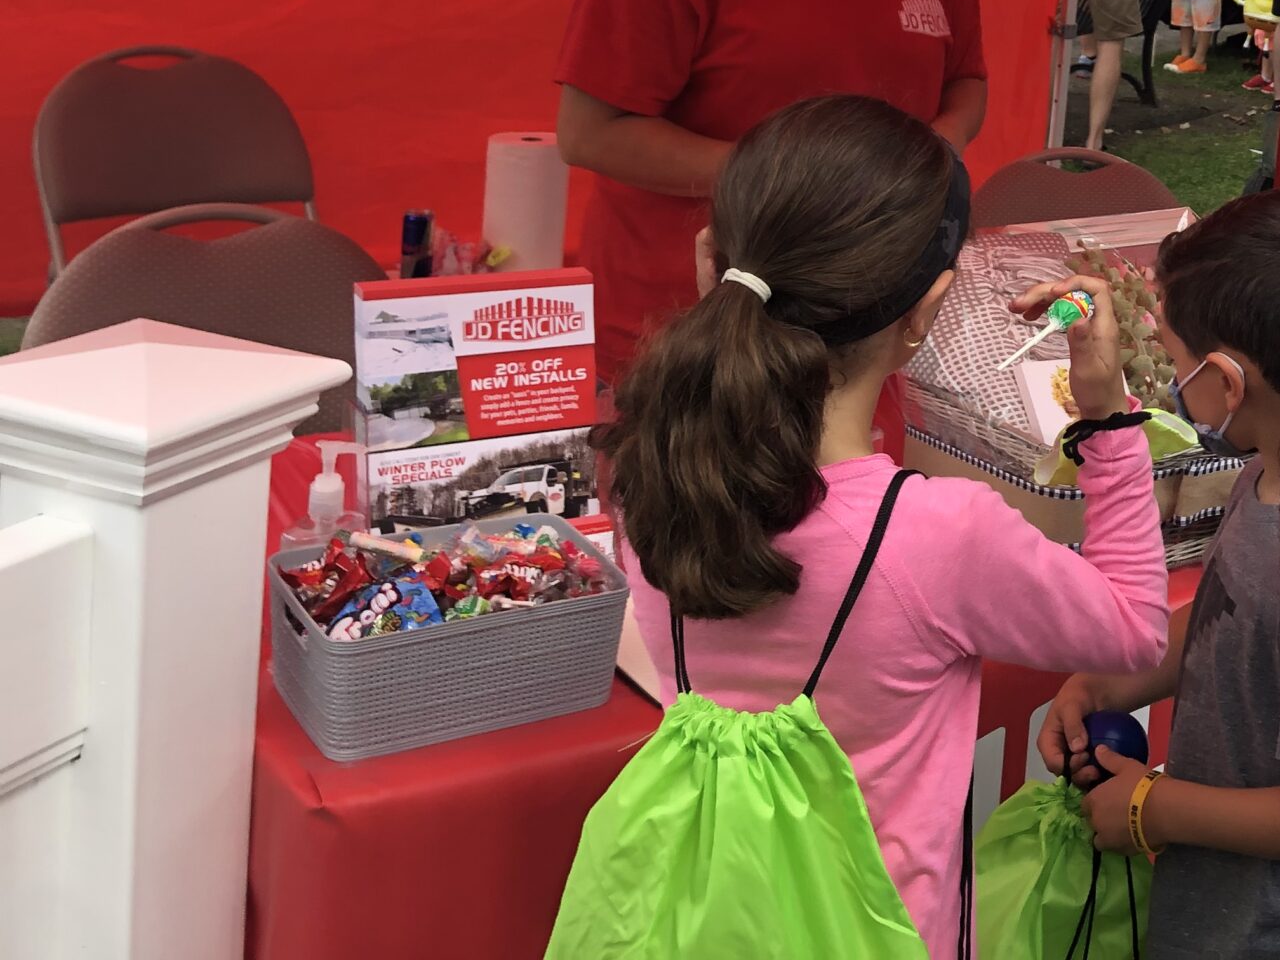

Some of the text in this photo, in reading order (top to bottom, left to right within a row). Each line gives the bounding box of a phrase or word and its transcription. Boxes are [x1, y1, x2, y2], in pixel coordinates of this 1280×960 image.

[465, 314, 581, 340] JD FENCING
[495, 357, 563, 376] 20% OFF
[470, 368, 588, 391] NEW INSTALLS
[377, 462, 426, 477] WINTER
[430, 457, 466, 469] PLOW
[391, 468, 453, 485] SPECIALS
